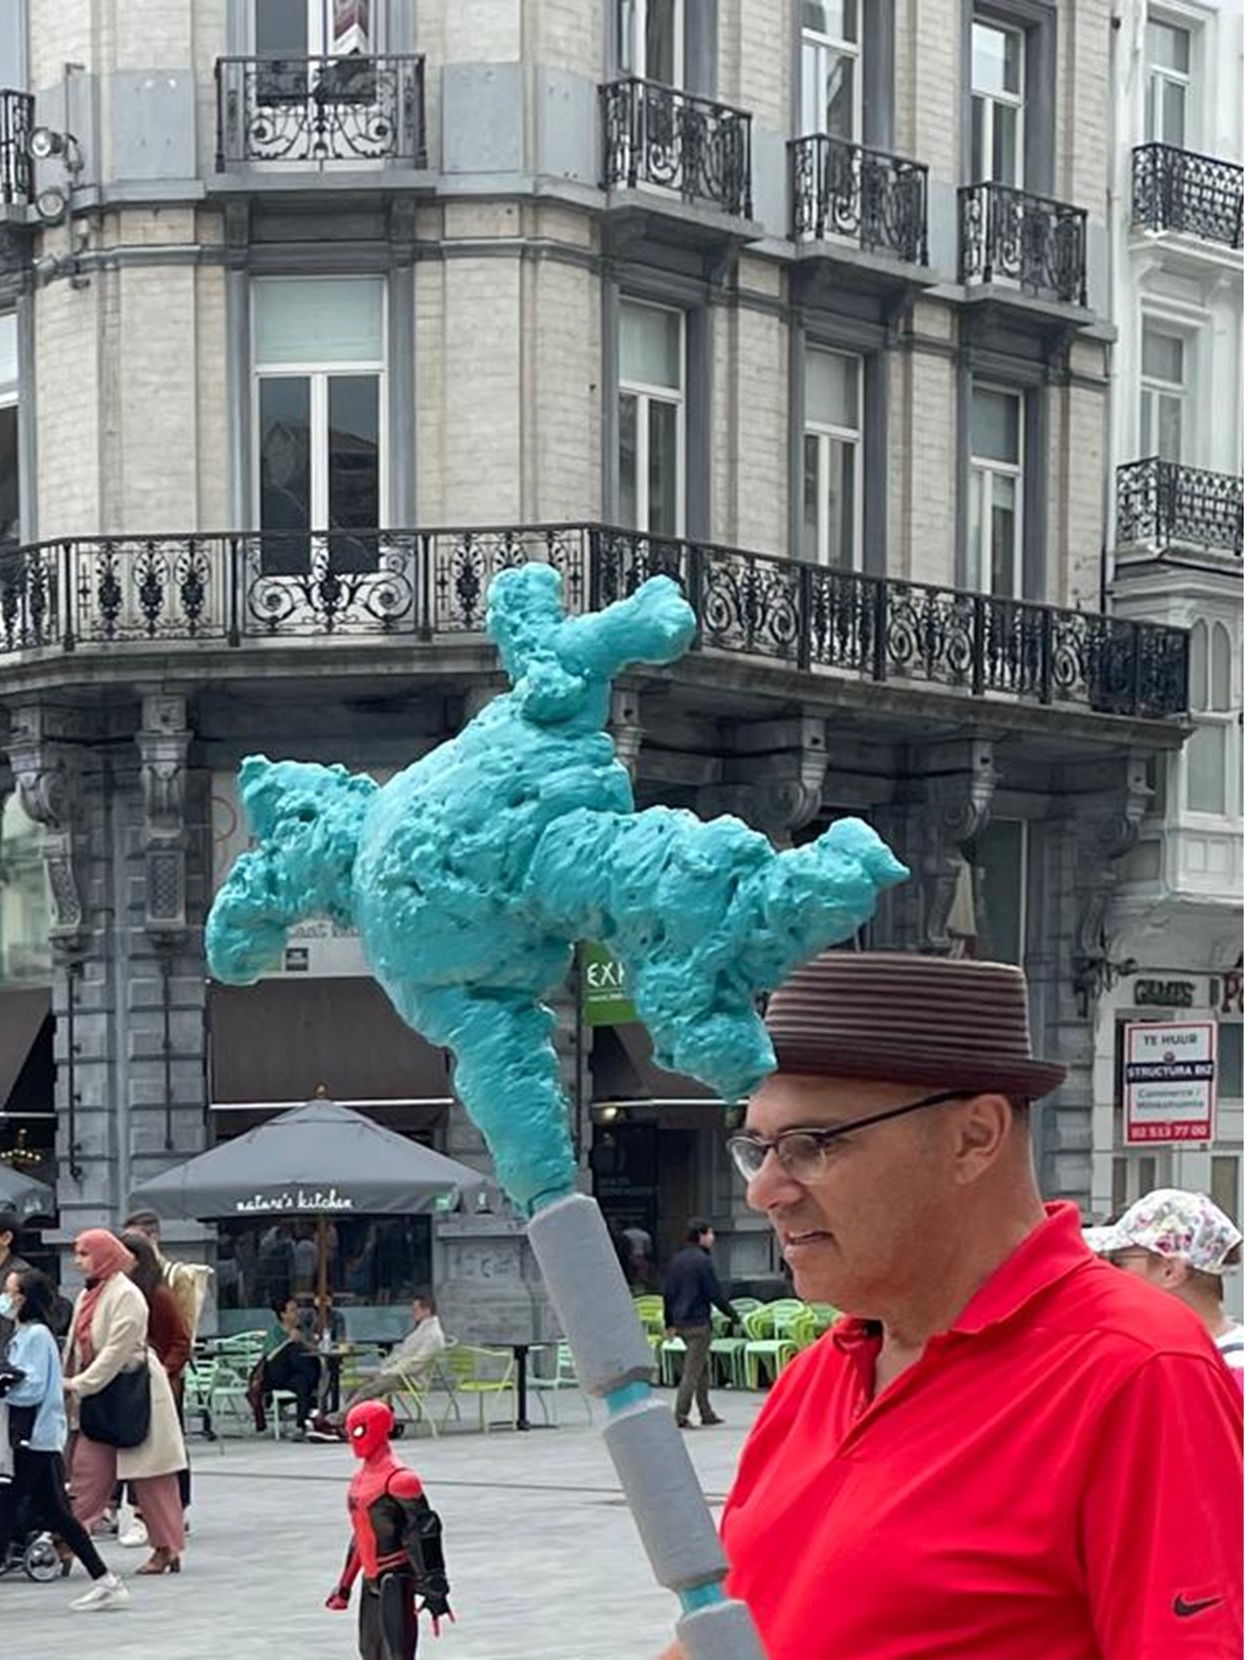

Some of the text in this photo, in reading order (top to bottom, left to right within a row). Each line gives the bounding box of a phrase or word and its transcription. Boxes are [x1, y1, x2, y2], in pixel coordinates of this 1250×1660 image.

[1143, 1033, 1198, 1046] TE HUUR
[236, 1188, 353, 1211] nature's kitchen
